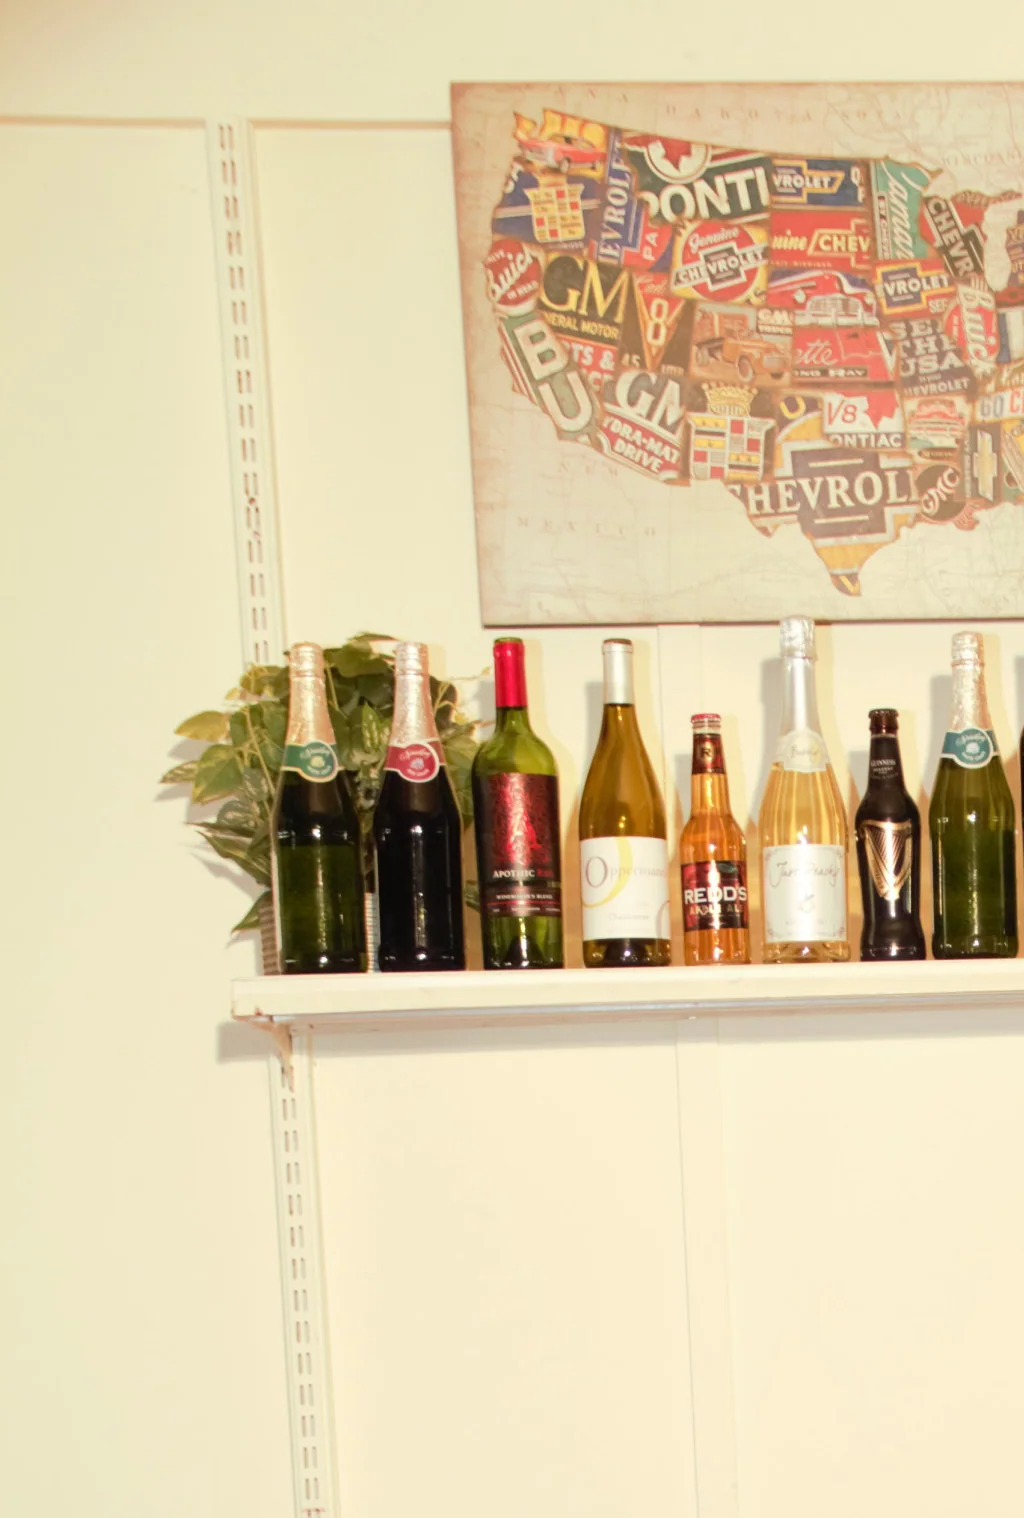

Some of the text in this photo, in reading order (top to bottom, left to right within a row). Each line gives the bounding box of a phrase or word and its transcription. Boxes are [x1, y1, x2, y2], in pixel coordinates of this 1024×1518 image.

[678, 248, 765, 286] CHEVROLET
[493, 868, 536, 879] APOTHIC
[684, 886, 748, 905] REDD'S
